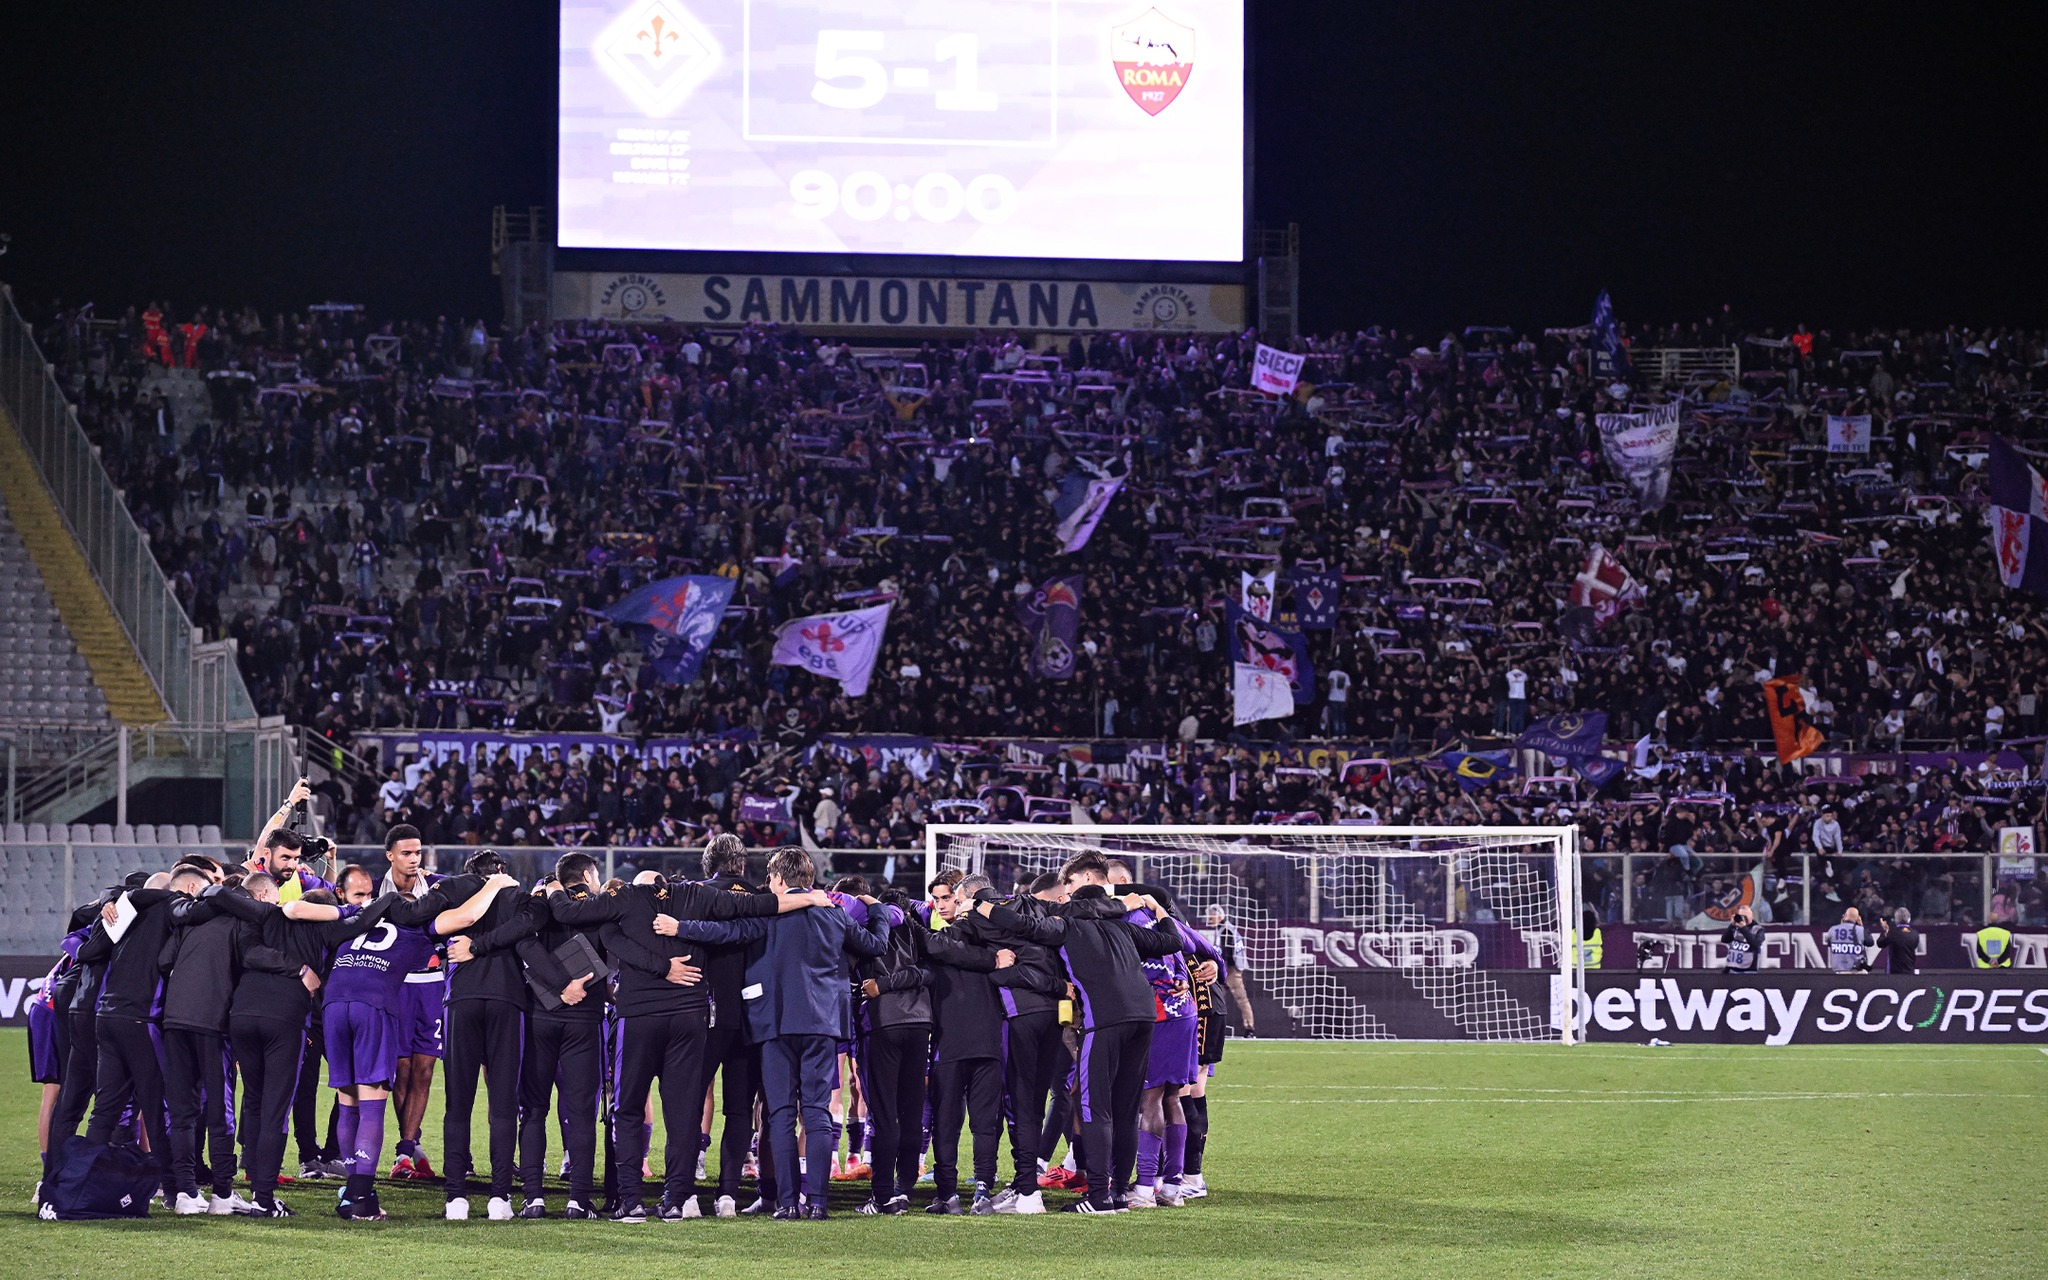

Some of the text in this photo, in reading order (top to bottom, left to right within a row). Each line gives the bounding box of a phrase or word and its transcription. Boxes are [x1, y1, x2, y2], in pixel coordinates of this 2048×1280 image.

[810, 28, 999, 112] 5-1
[1123, 69, 1182, 86] ROMA
[1142, 91, 1165, 102] 1927
[789, 169, 1018, 223] 90:00
[703, 275, 1099, 327] SAMMONTANA
[1258, 349, 1300, 375] SIECI
[1831, 942, 1862, 954] PHOTO
[352, 960, 388, 972] HOLDING
[354, 953, 391, 967] LAMIONI
[1816, 986, 2048, 1033] SCORES
